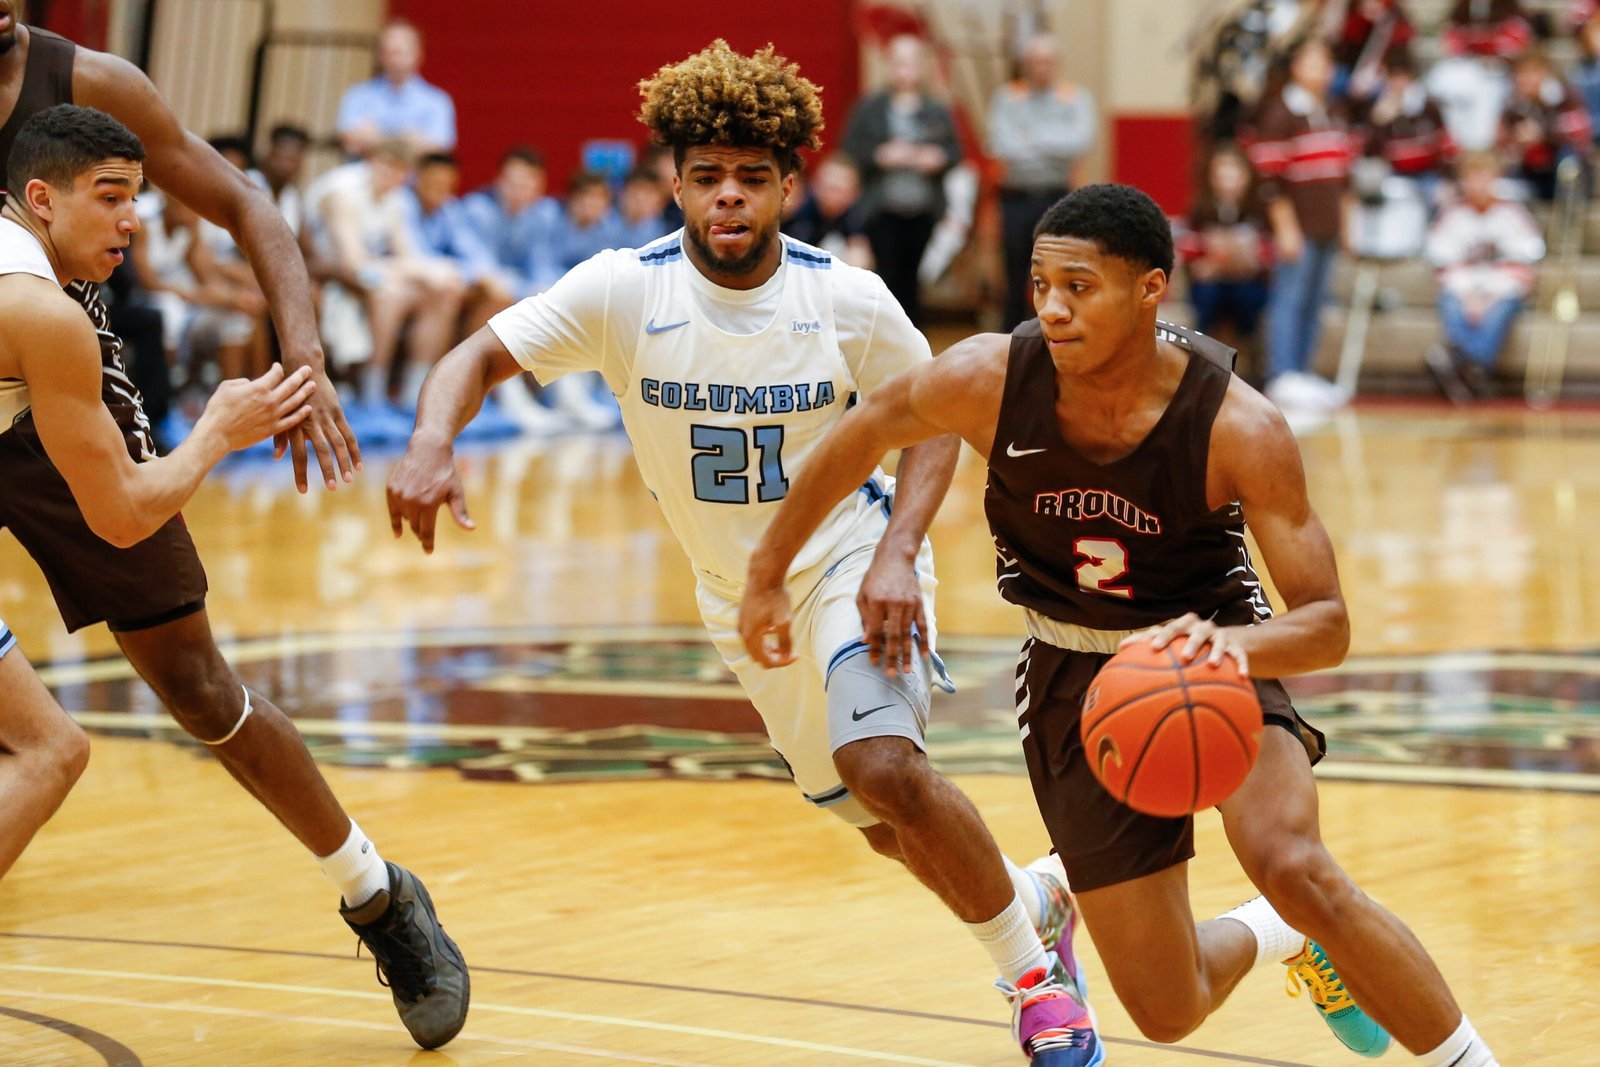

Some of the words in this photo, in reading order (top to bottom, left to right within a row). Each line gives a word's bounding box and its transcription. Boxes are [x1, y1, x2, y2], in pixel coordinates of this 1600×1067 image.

[792, 320, 811, 334] Ivy
[641, 378, 835, 414] COLUMBIA
[690, 424, 790, 504] 21
[1034, 488, 1162, 534] BROWN
[1073, 537, 1133, 599] 2
